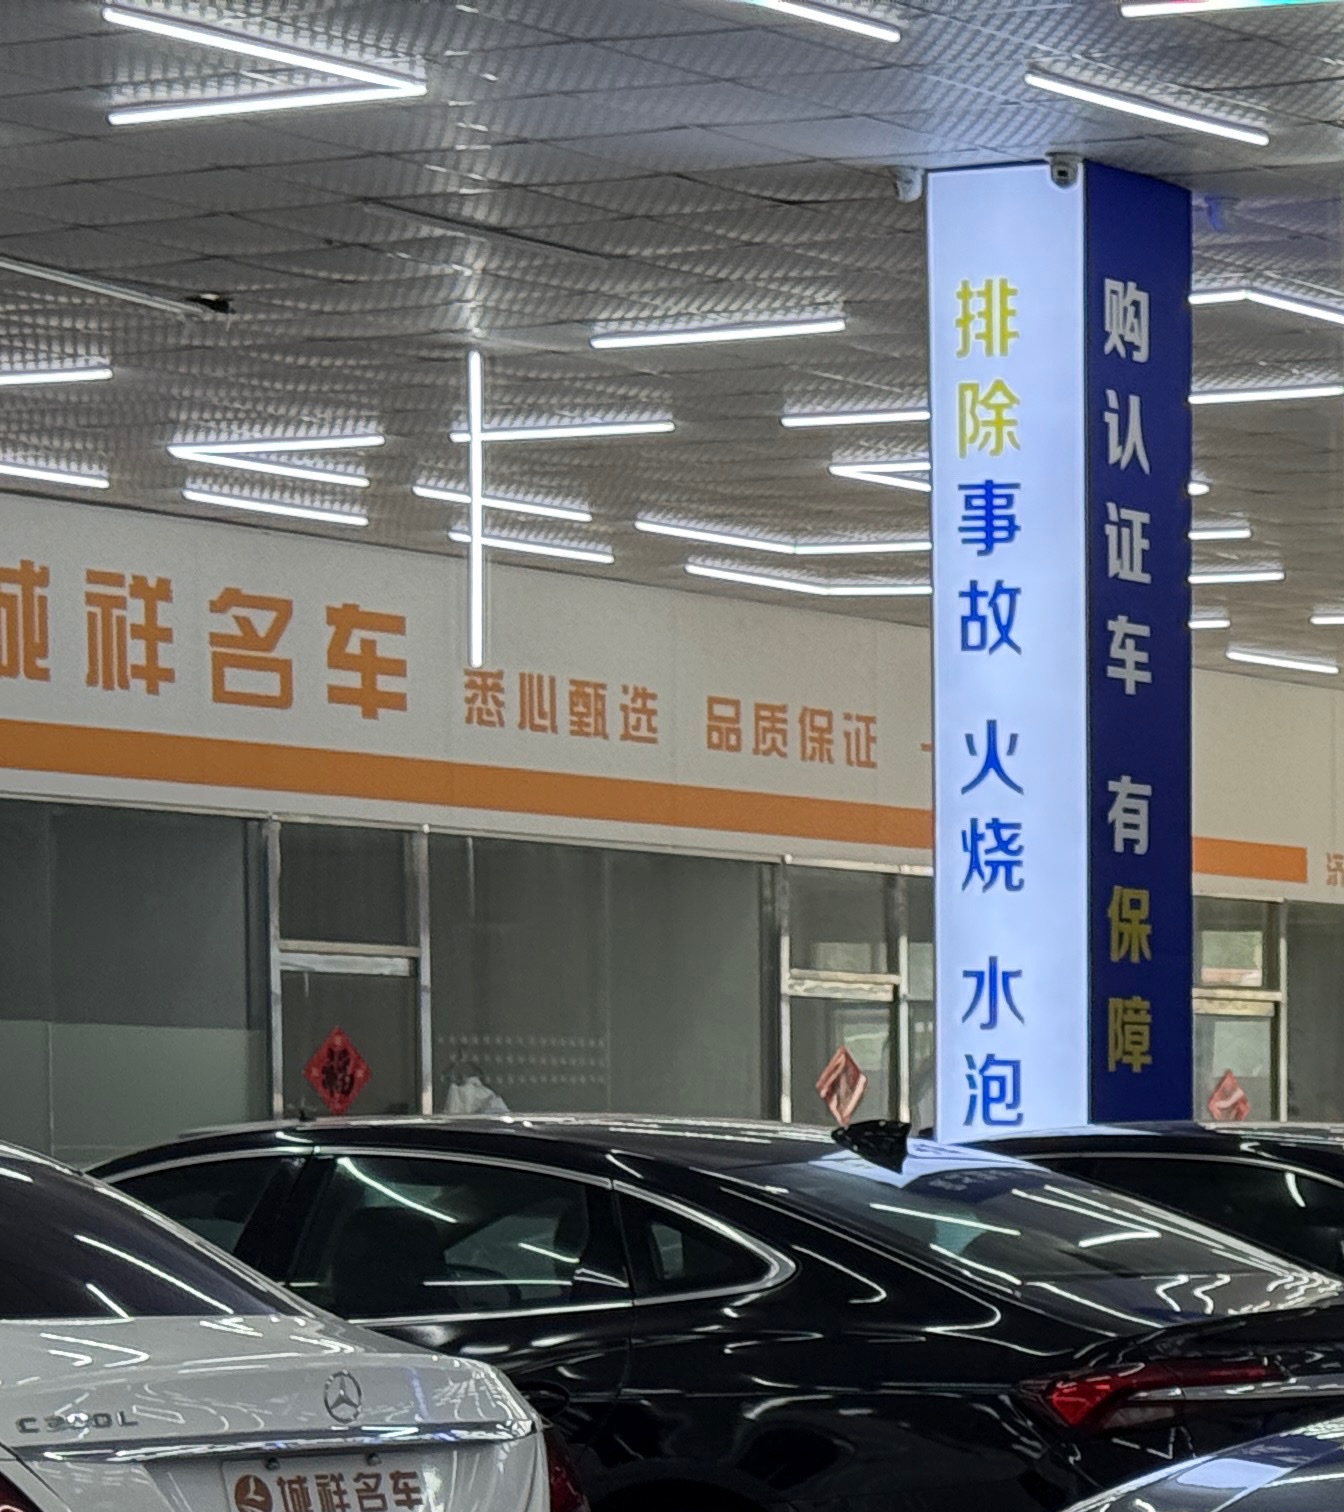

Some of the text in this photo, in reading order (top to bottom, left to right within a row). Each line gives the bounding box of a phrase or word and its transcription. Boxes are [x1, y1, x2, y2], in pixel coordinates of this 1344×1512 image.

[463, 669, 878, 770] 悉心甄选 品质保证
[955, 277, 1025, 1128] 排除事故 火烧 水泡
[1103, 277, 1153, 1074] 购认证车 有保障
